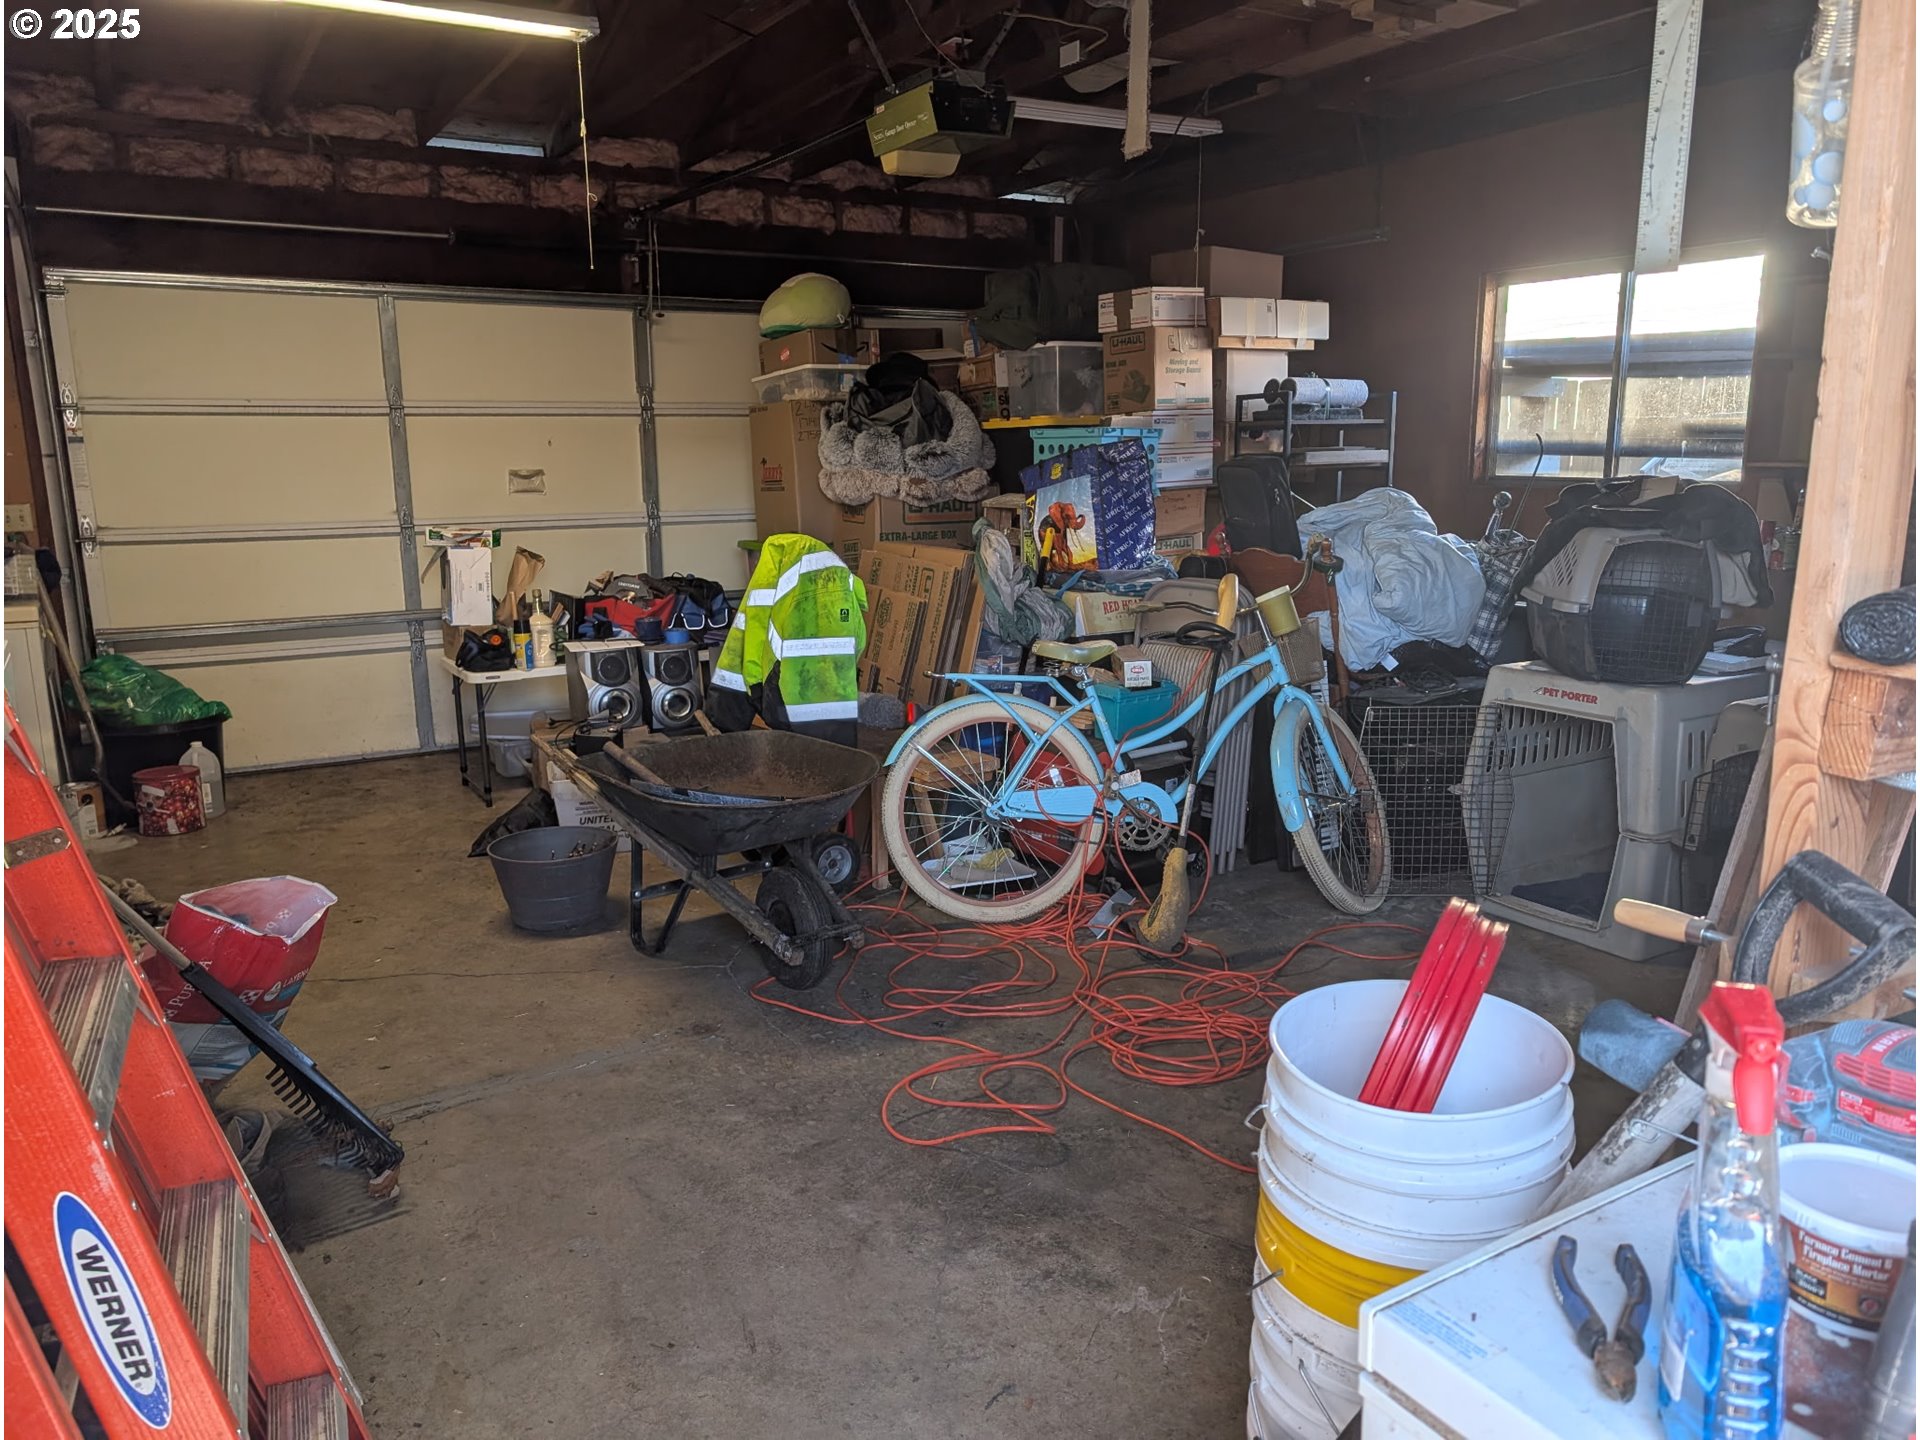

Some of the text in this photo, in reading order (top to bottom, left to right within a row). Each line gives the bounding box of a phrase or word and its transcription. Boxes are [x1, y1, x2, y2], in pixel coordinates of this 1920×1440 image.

[1112, 335, 1143, 347] U-HAUL
[879, 530, 958, 542] EXTRA-LARGE BOX
[1113, 540, 1134, 557] AFRICA
[1103, 600, 1120, 614] RED
[1543, 686, 1598, 704] PET PORTER
[1802, 1245, 1889, 1281] Fireplace Mortar
[76, 1243, 153, 1382] WERNER
